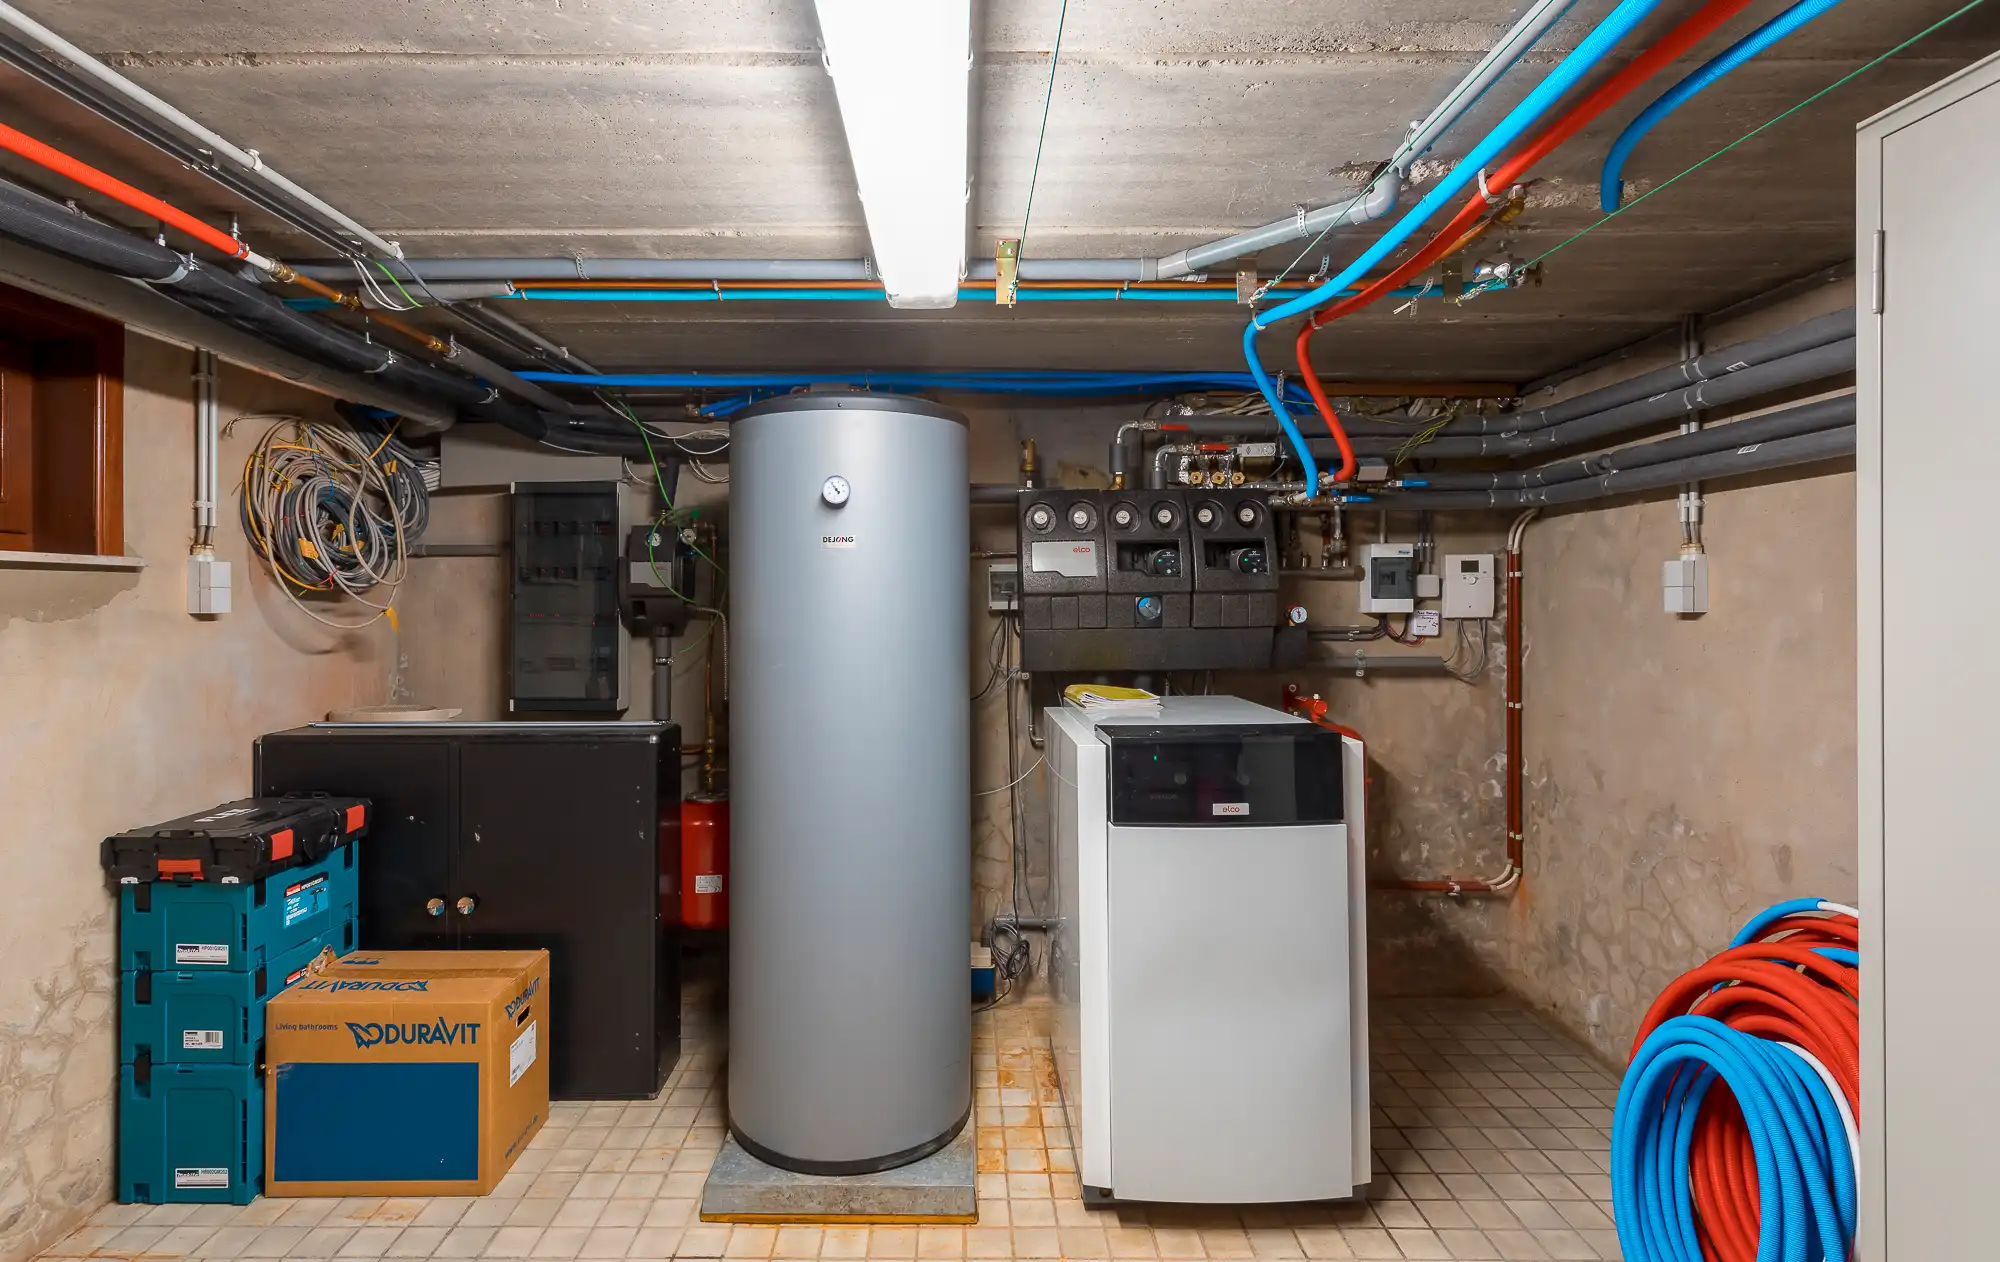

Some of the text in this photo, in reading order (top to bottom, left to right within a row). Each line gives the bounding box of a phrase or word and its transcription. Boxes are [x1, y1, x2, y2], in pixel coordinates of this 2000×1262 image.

[299, 980, 396, 993] DURAVIT
[275, 1023, 338, 1031] Living bathrooms
[384, 1016, 481, 1046] DURAVIT
